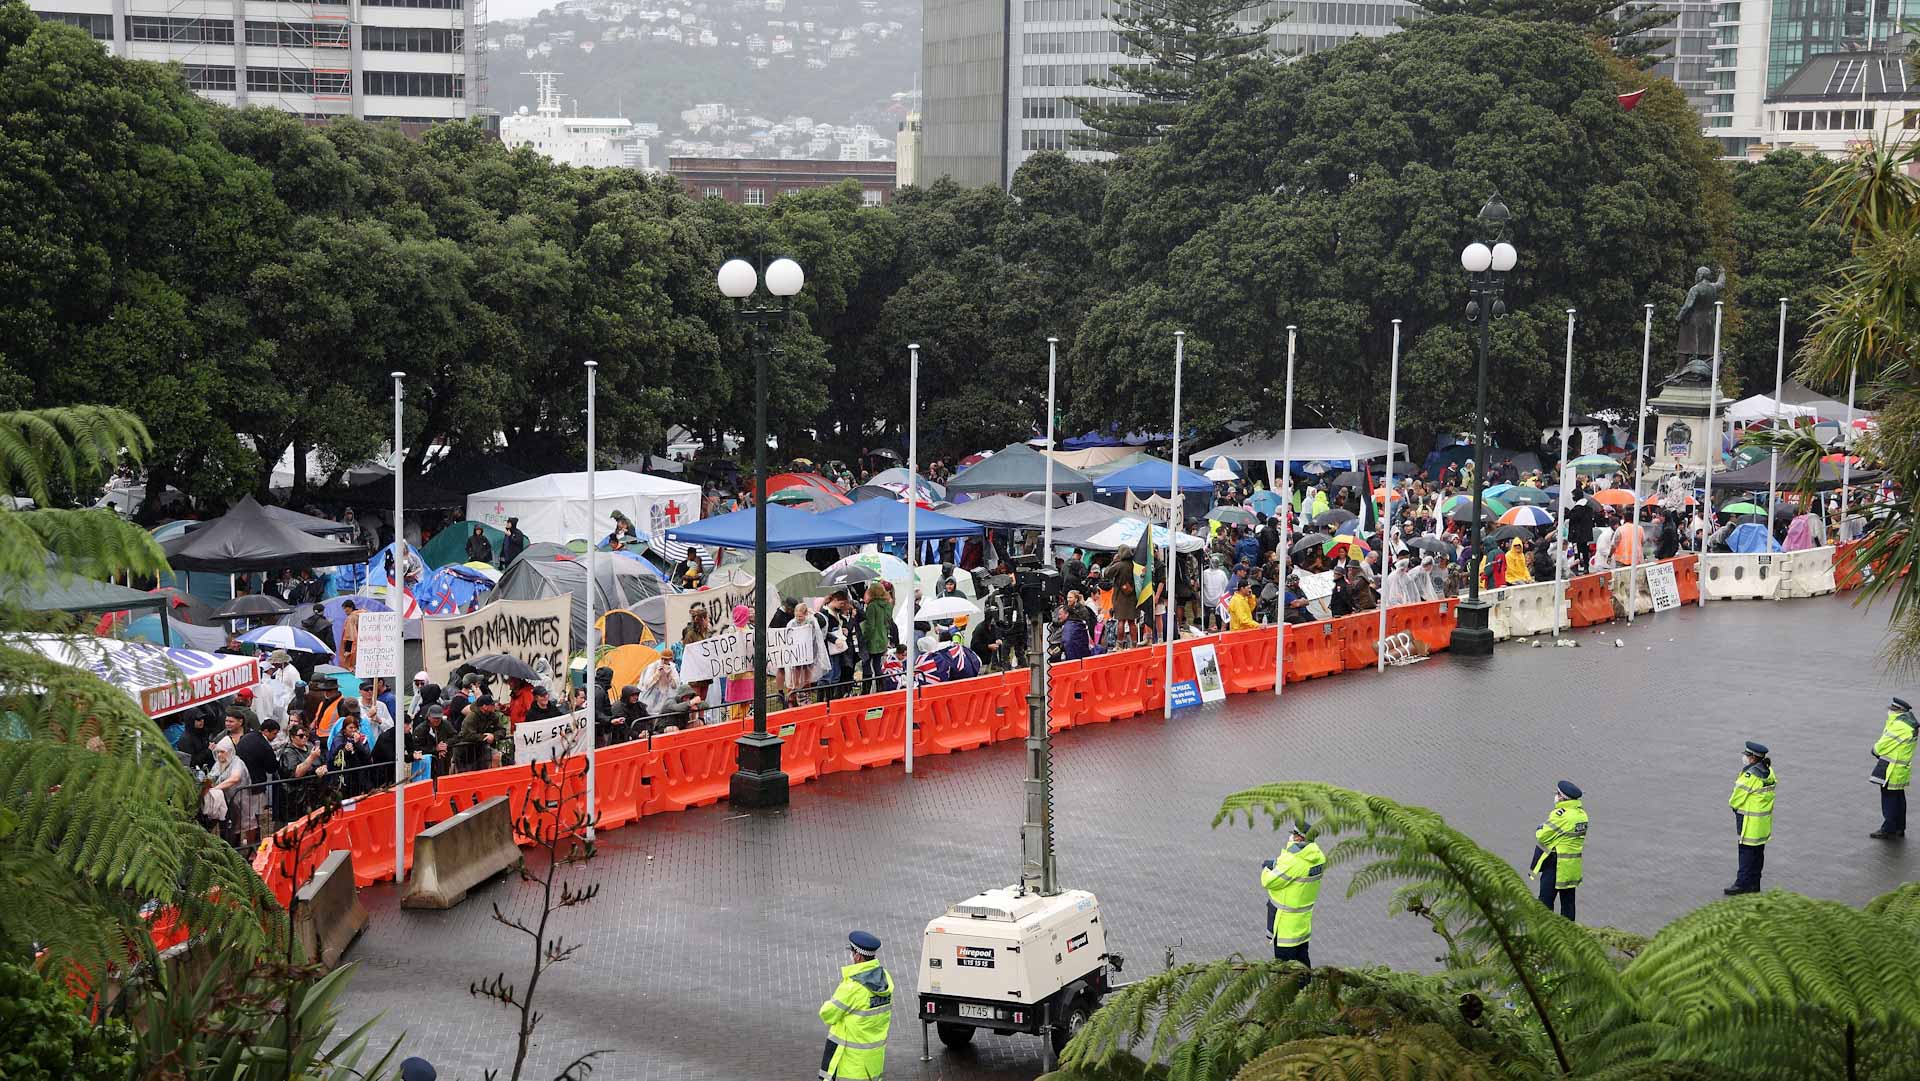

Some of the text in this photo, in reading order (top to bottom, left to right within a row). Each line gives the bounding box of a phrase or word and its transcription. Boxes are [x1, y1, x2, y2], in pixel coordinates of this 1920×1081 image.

[1656, 595, 1670, 608] FREE
[444, 613, 560, 662] END MANDATES
[702, 635, 737, 658] STOP
[363, 654, 394, 662] INSTINCT
[193, 678, 212, 699] WE
[214, 663, 253, 693] STAND!
[523, 730, 543, 746] WE
[960, 947, 992, 958] Hirepool
